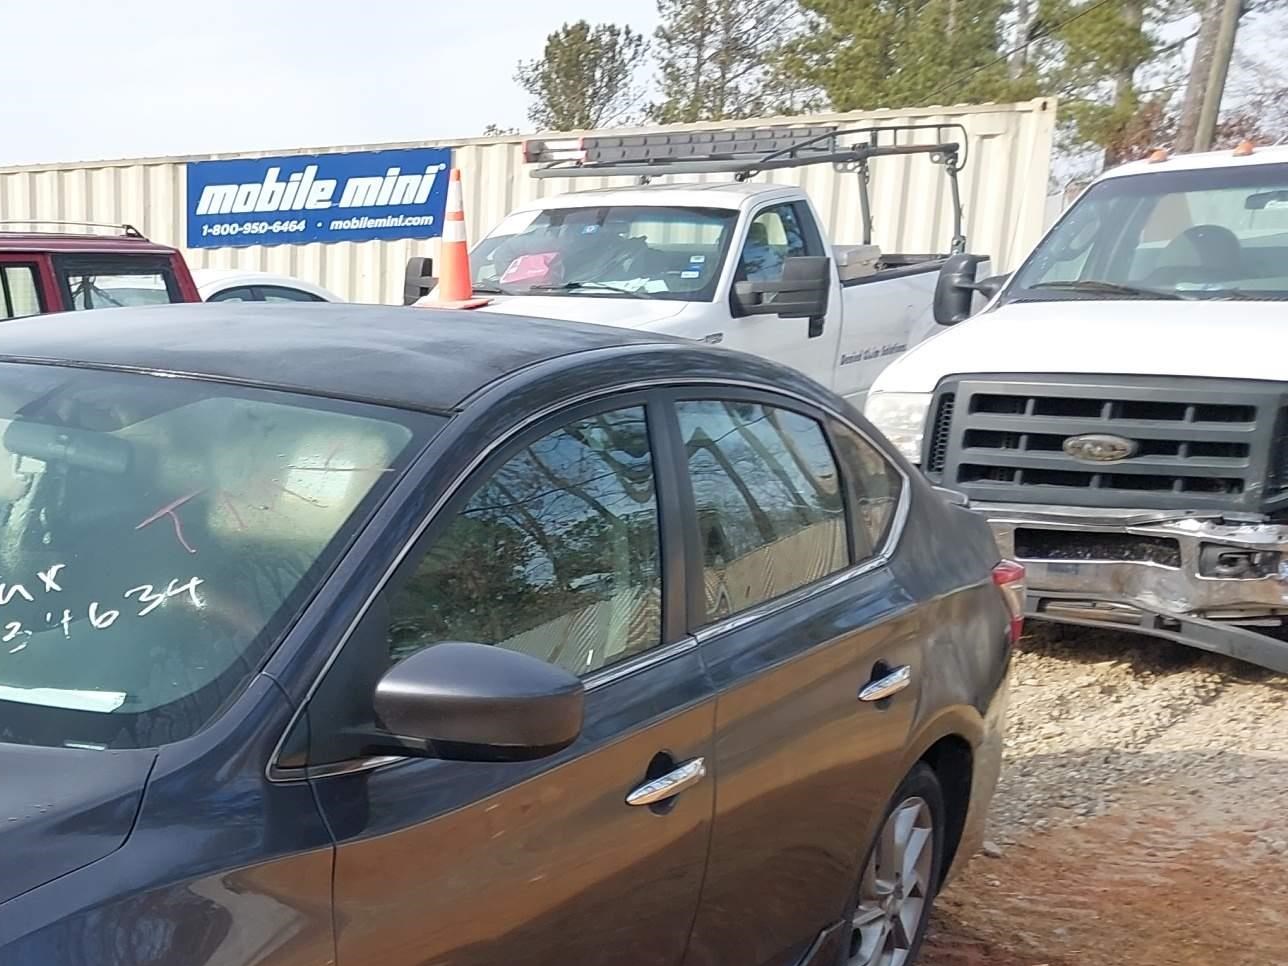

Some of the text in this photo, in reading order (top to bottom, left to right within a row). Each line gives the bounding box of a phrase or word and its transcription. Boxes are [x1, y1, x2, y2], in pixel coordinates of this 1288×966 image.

[196, 163, 441, 215] mobile mini
[202, 215, 433, 236] 1-800-950-6464 mobilemini.com
